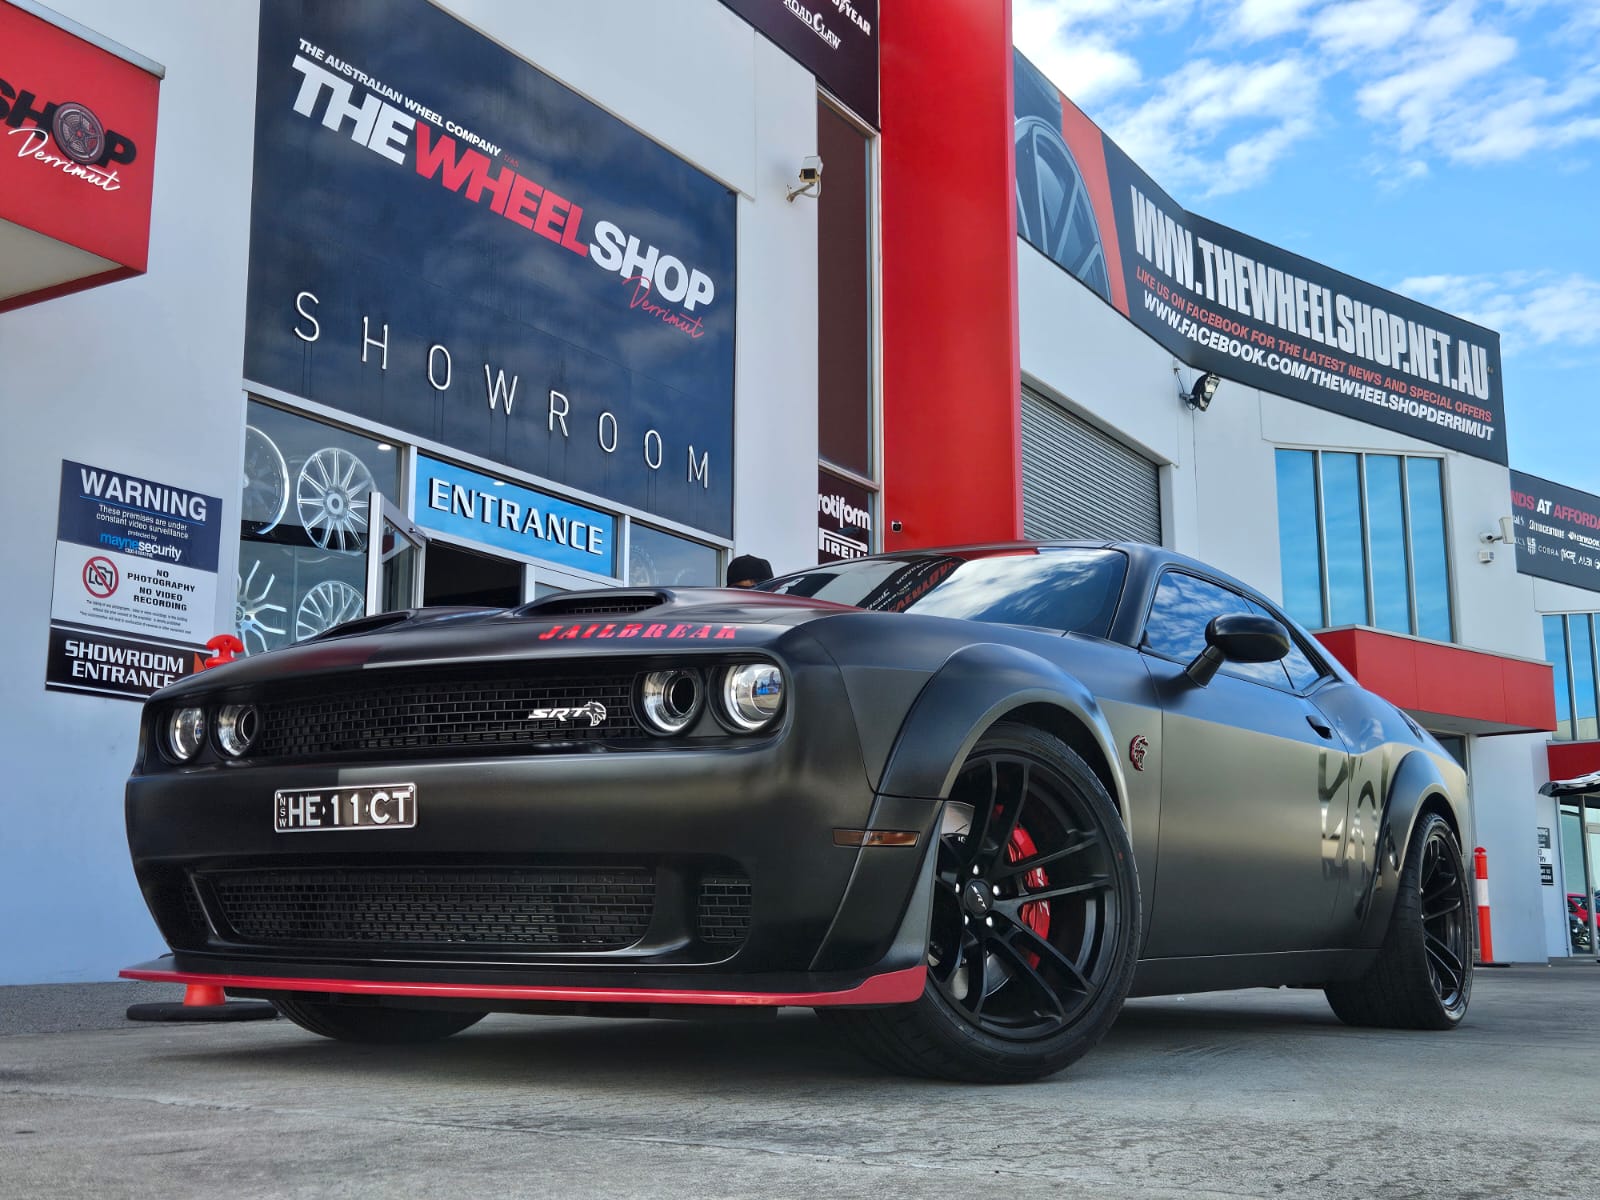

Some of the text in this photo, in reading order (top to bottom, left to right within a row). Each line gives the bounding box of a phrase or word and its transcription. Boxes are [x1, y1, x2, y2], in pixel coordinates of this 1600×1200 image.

[299, 38, 501, 157] THE AUSTRALIAN WHEEL COMPANY
[8, 128, 120, 191] Derrimut
[621, 275, 705, 338] Derrimut
[1131, 184, 1489, 400] WWW.THEWHEELSHOP.NET.AU
[1136, 265, 1492, 423] LIKE US ON FACEBOOK FOR THE LATEST NEWS AND SPECIAL OFFERS
[1144, 289, 1494, 440] WWW.FACEBOOK.COM/THEWHEELSHOPDERRIMUT
[293, 291, 710, 489] SHOWROOM
[80, 468, 207, 522] WARNING
[818, 493, 870, 530] rotiform
[1536, 498, 1552, 515] AT
[96, 513, 127, 526] constant
[128, 520, 147, 531] video
[99, 504, 187, 531] These premises are under
[429, 476, 604, 555] ENTRANCE
[127, 572, 195, 592] PHOTOGRAPHY
[156, 569, 169, 578] NO
[133, 594, 187, 611] RECORDING
[139, 586, 183, 602] NO VIDEO
[538, 623, 745, 641] JAILBREAK
[65, 639, 184, 674] SHOWROOM
[528, 707, 588, 722] SRT
